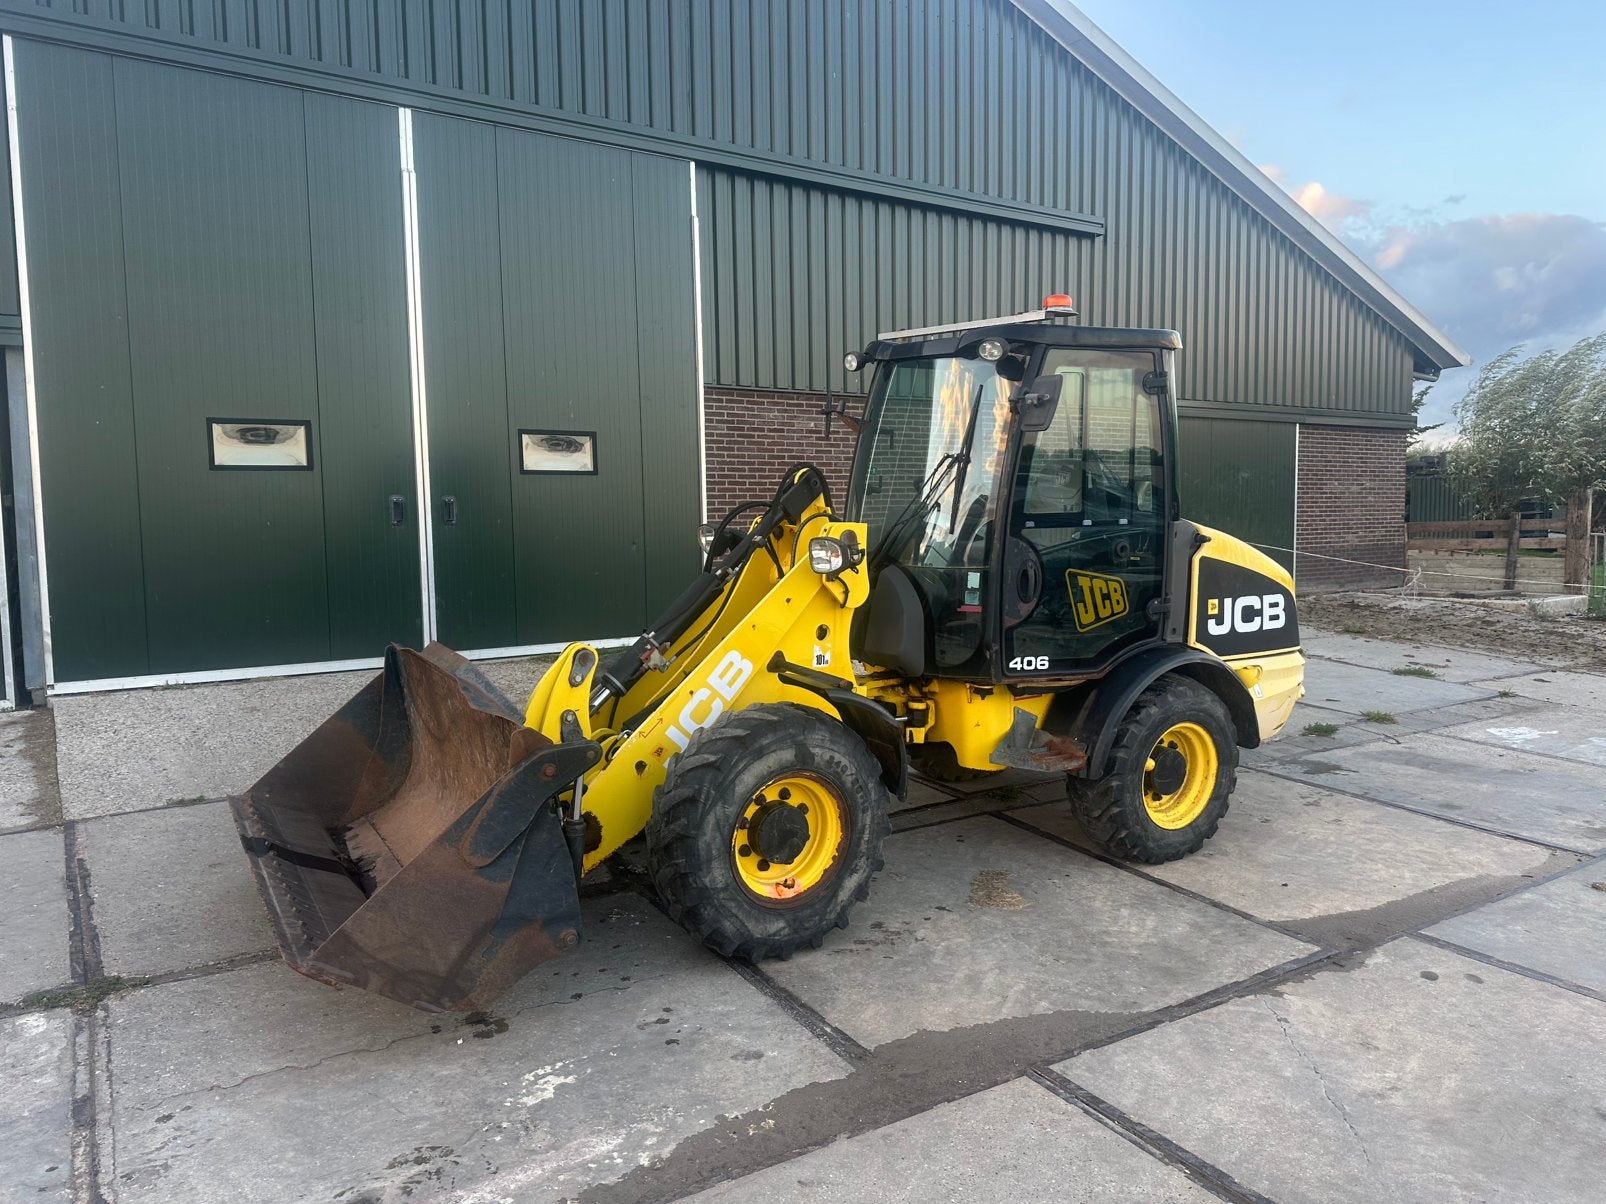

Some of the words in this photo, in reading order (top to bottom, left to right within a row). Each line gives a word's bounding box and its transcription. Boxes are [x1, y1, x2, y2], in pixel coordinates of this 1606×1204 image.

[1077, 575, 1125, 625] JCB
[1207, 593, 1286, 636] JCB
[1009, 655, 1049, 671] 406
